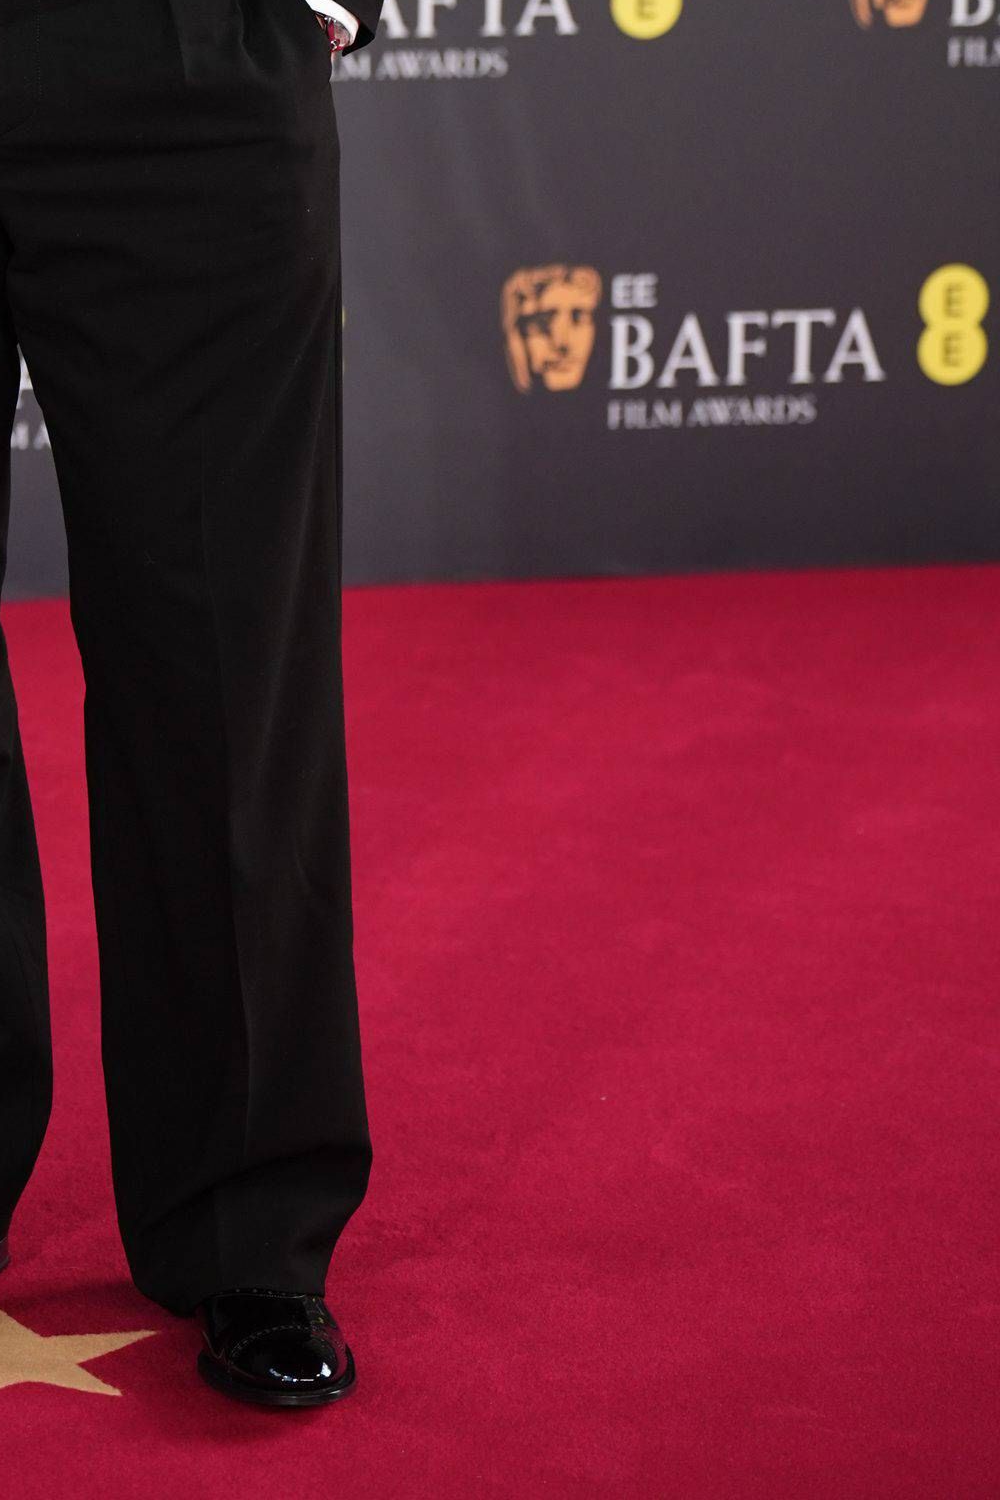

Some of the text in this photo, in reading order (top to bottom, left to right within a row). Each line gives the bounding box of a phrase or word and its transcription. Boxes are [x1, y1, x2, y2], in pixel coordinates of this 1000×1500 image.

[376, 48, 508, 80] AWARDS
[611, 273, 658, 309] EE
[609, 308, 885, 390] BAFTA
[607, 396, 817, 430] FILM AWARDS
